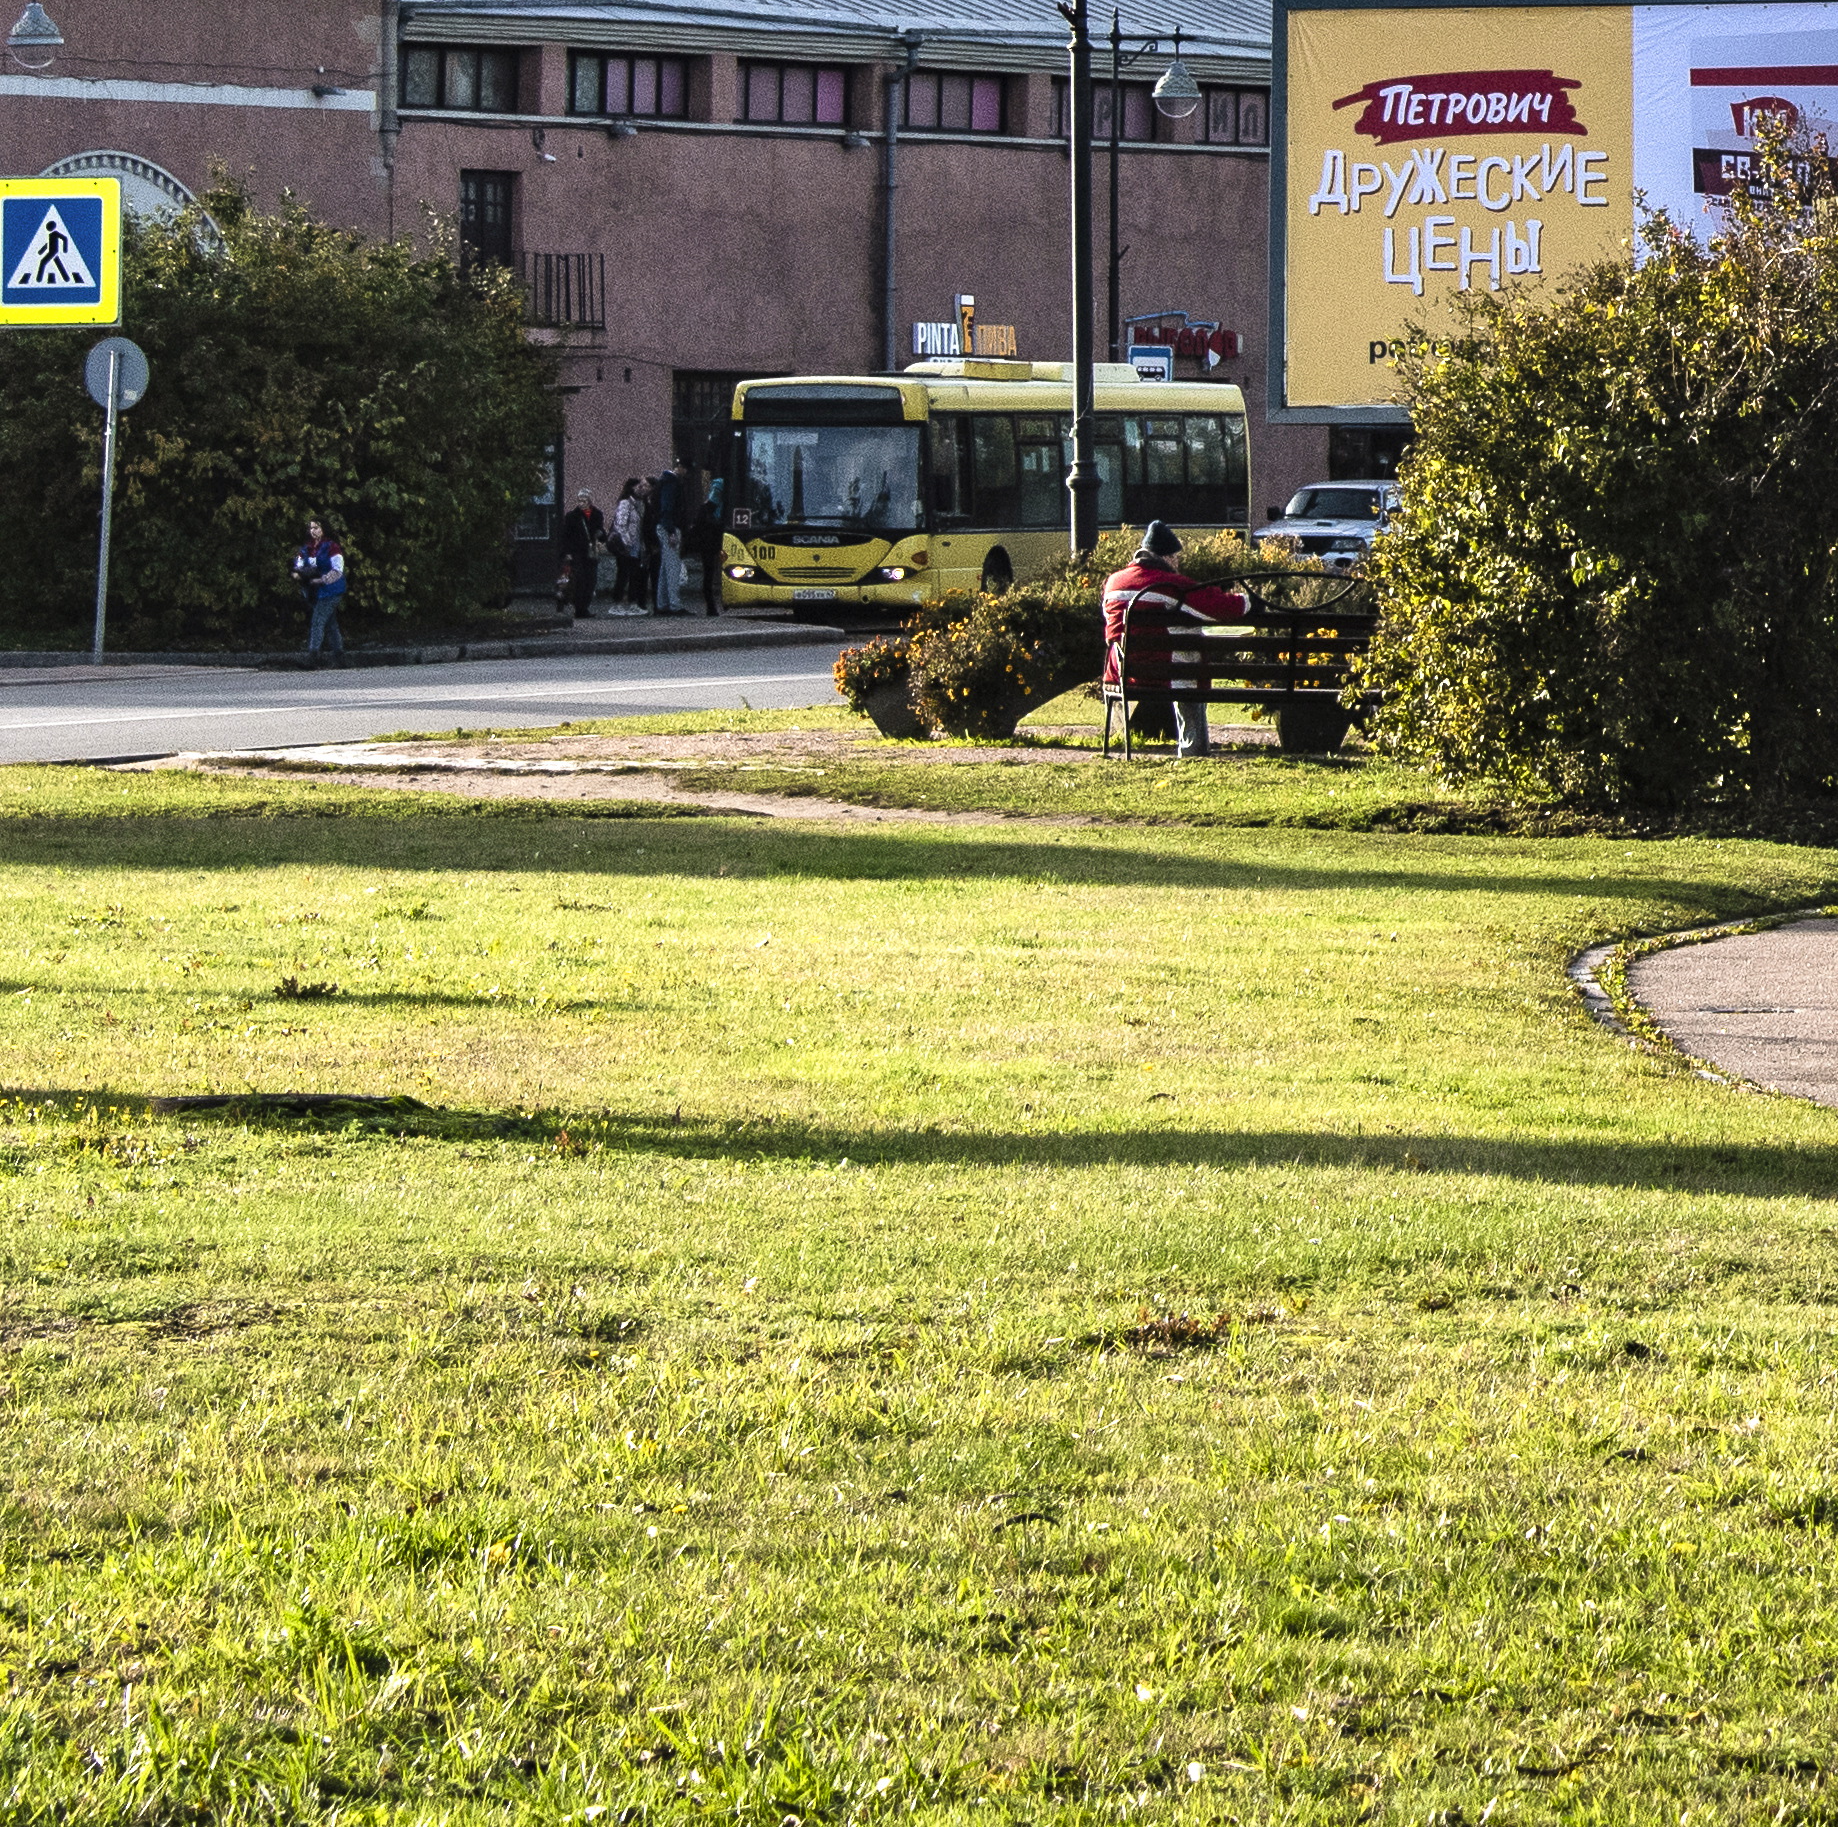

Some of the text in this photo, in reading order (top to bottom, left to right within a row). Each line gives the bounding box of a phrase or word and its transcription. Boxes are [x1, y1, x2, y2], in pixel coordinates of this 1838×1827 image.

[1310, 143, 1609, 216] ДРУЖЕСКИЕ
[1384, 217, 1543, 296] ЦЕНЫ
[914, 322, 960, 355] PINTA
[736, 514, 749, 525] 12
[792, 535, 839, 544] SCANIA
[752, 545, 776, 560] 100
